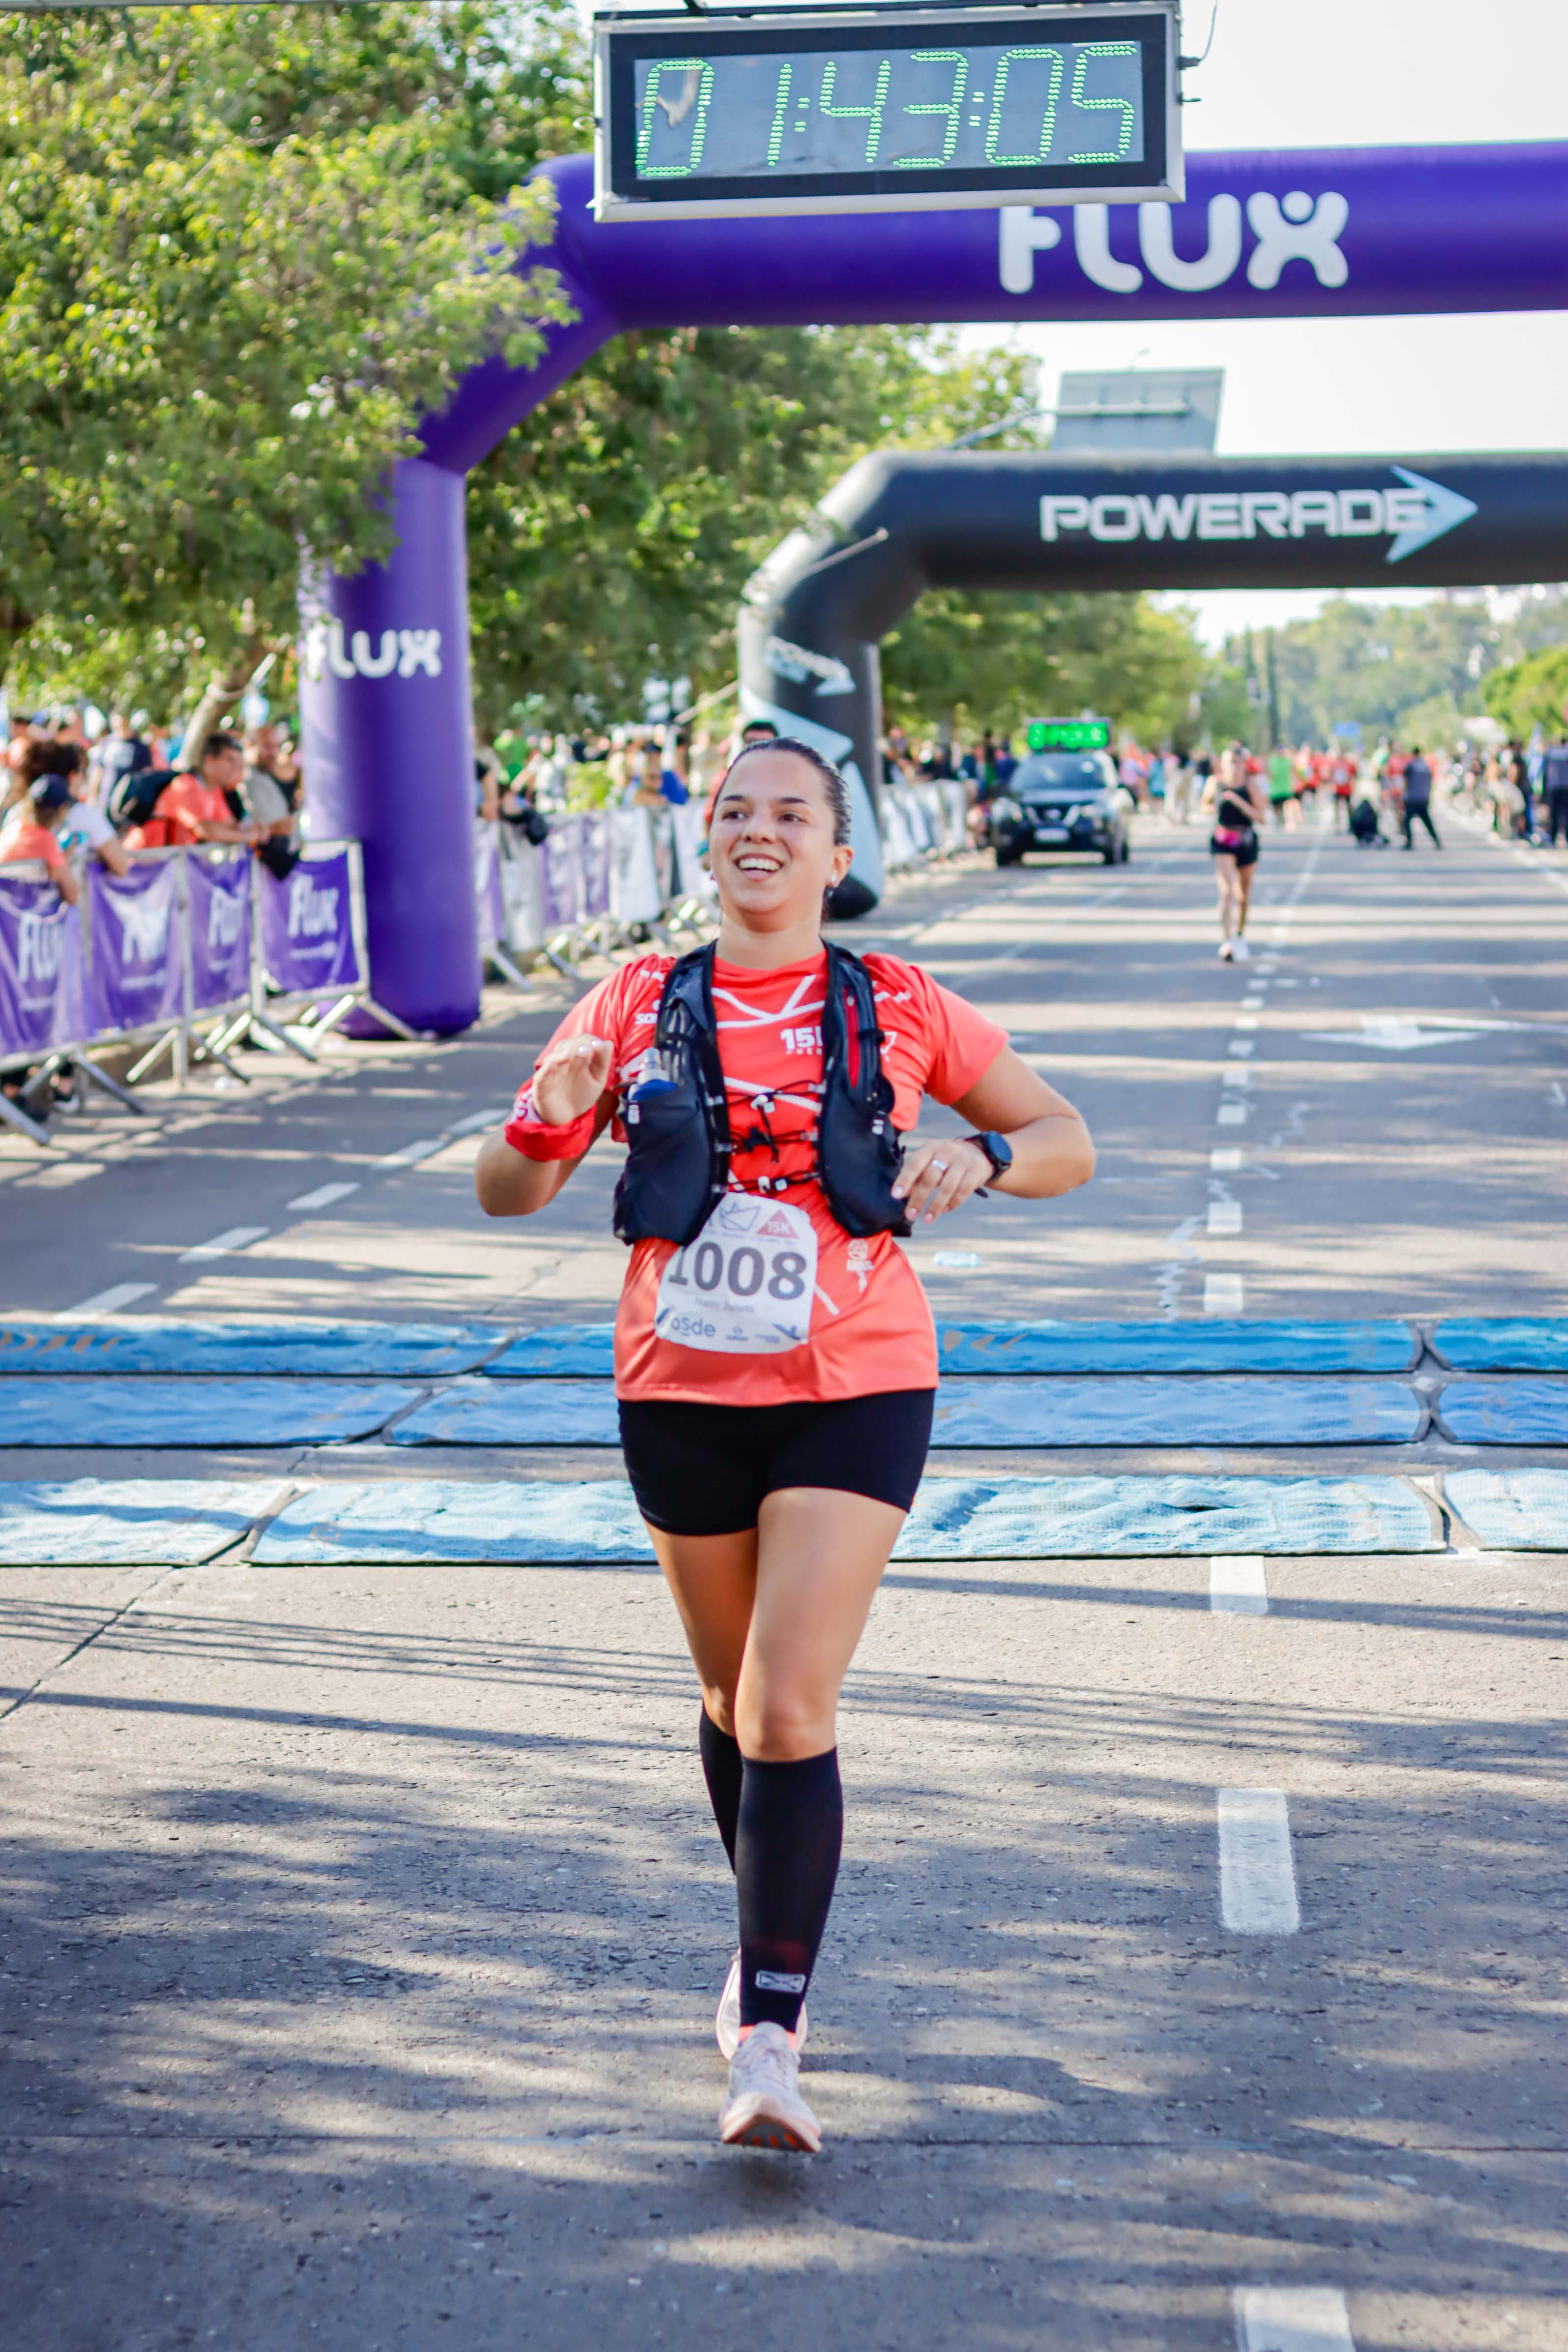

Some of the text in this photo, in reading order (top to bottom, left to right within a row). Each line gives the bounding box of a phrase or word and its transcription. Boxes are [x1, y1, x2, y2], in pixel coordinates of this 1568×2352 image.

[634, 45, 1138, 176] 01:43:05
[999, 191, 1349, 294] FLUX
[1040, 488, 1427, 542] POWERADE
[668, 1241, 807, 1300] 1008
[671, 1317, 716, 1338] osde
